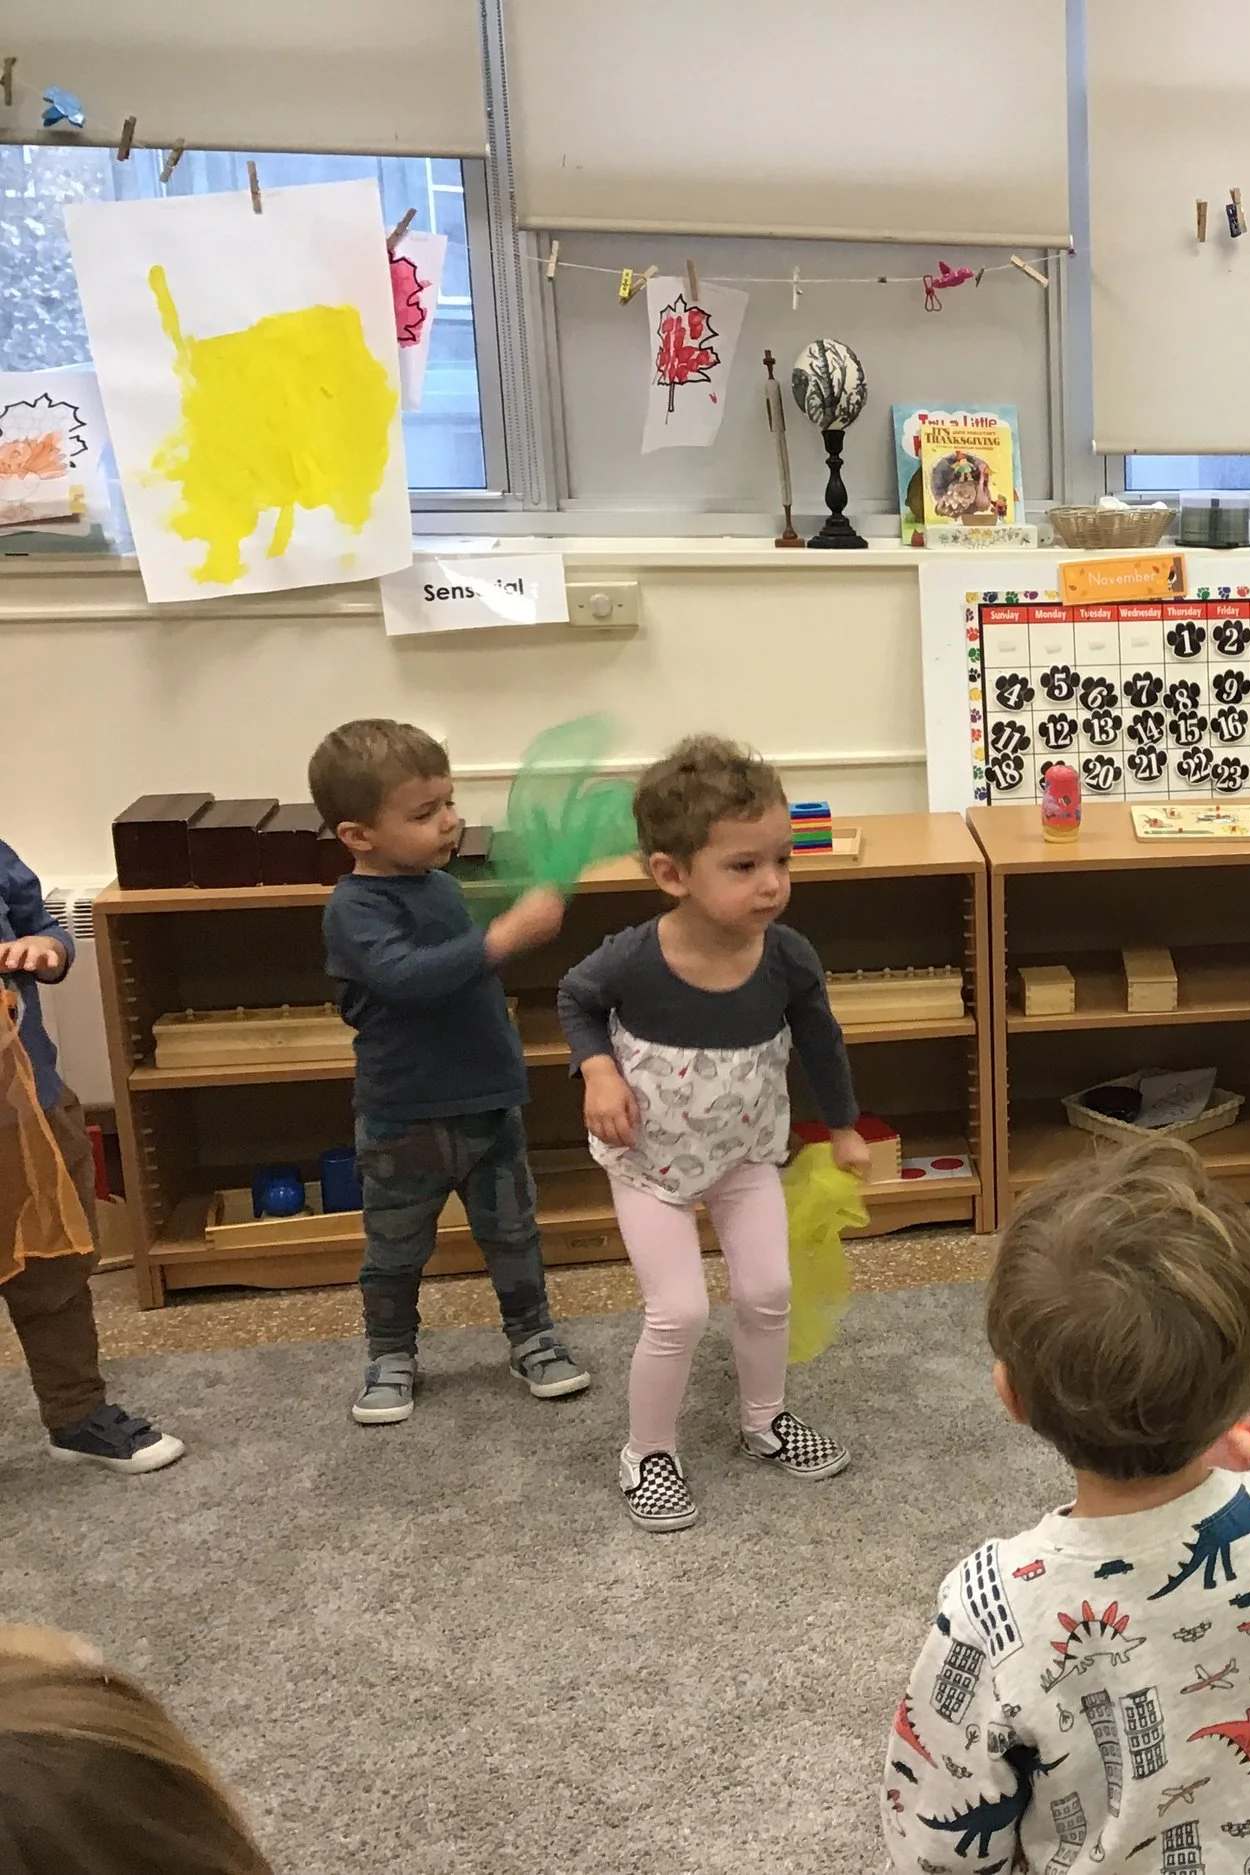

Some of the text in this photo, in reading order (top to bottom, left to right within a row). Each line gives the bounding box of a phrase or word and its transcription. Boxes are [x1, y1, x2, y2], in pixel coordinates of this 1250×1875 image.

[1088, 568, 1158, 585] November
[990, 610, 1019, 621] Sunday
[1035, 609, 1067, 621] Monday
[1079, 608, 1112, 619] Tuesday
[1120, 607, 1162, 619] Wednesday
[1167, 606, 1202, 618] Thursday
[1216, 606, 1240, 617] Friday
[1180, 630, 1193, 654] 1
[1224, 628, 1239, 652] 2
[1003, 684, 1021, 707] 4
[1054, 673, 1068, 697] 5
[1088, 686, 1107, 708] 6
[1136, 680, 1150, 704] 7
[1175, 688, 1192, 711] 8
[1222, 678, 1238, 701] 9
[995, 727, 1021, 753] 11
[1047, 721, 1070, 746] 12
[1091, 717, 1115, 742] 13
[1134, 717, 1162, 744] 14
[1177, 718, 1200, 744] 15
[1218, 713, 1243, 741] 16
[992, 760, 1019, 789] 18
[1085, 761, 1114, 789] 20
[1134, 753, 1160, 779] 21
[1183, 753, 1211, 783] 22
[1215, 765, 1242, 789] 23
